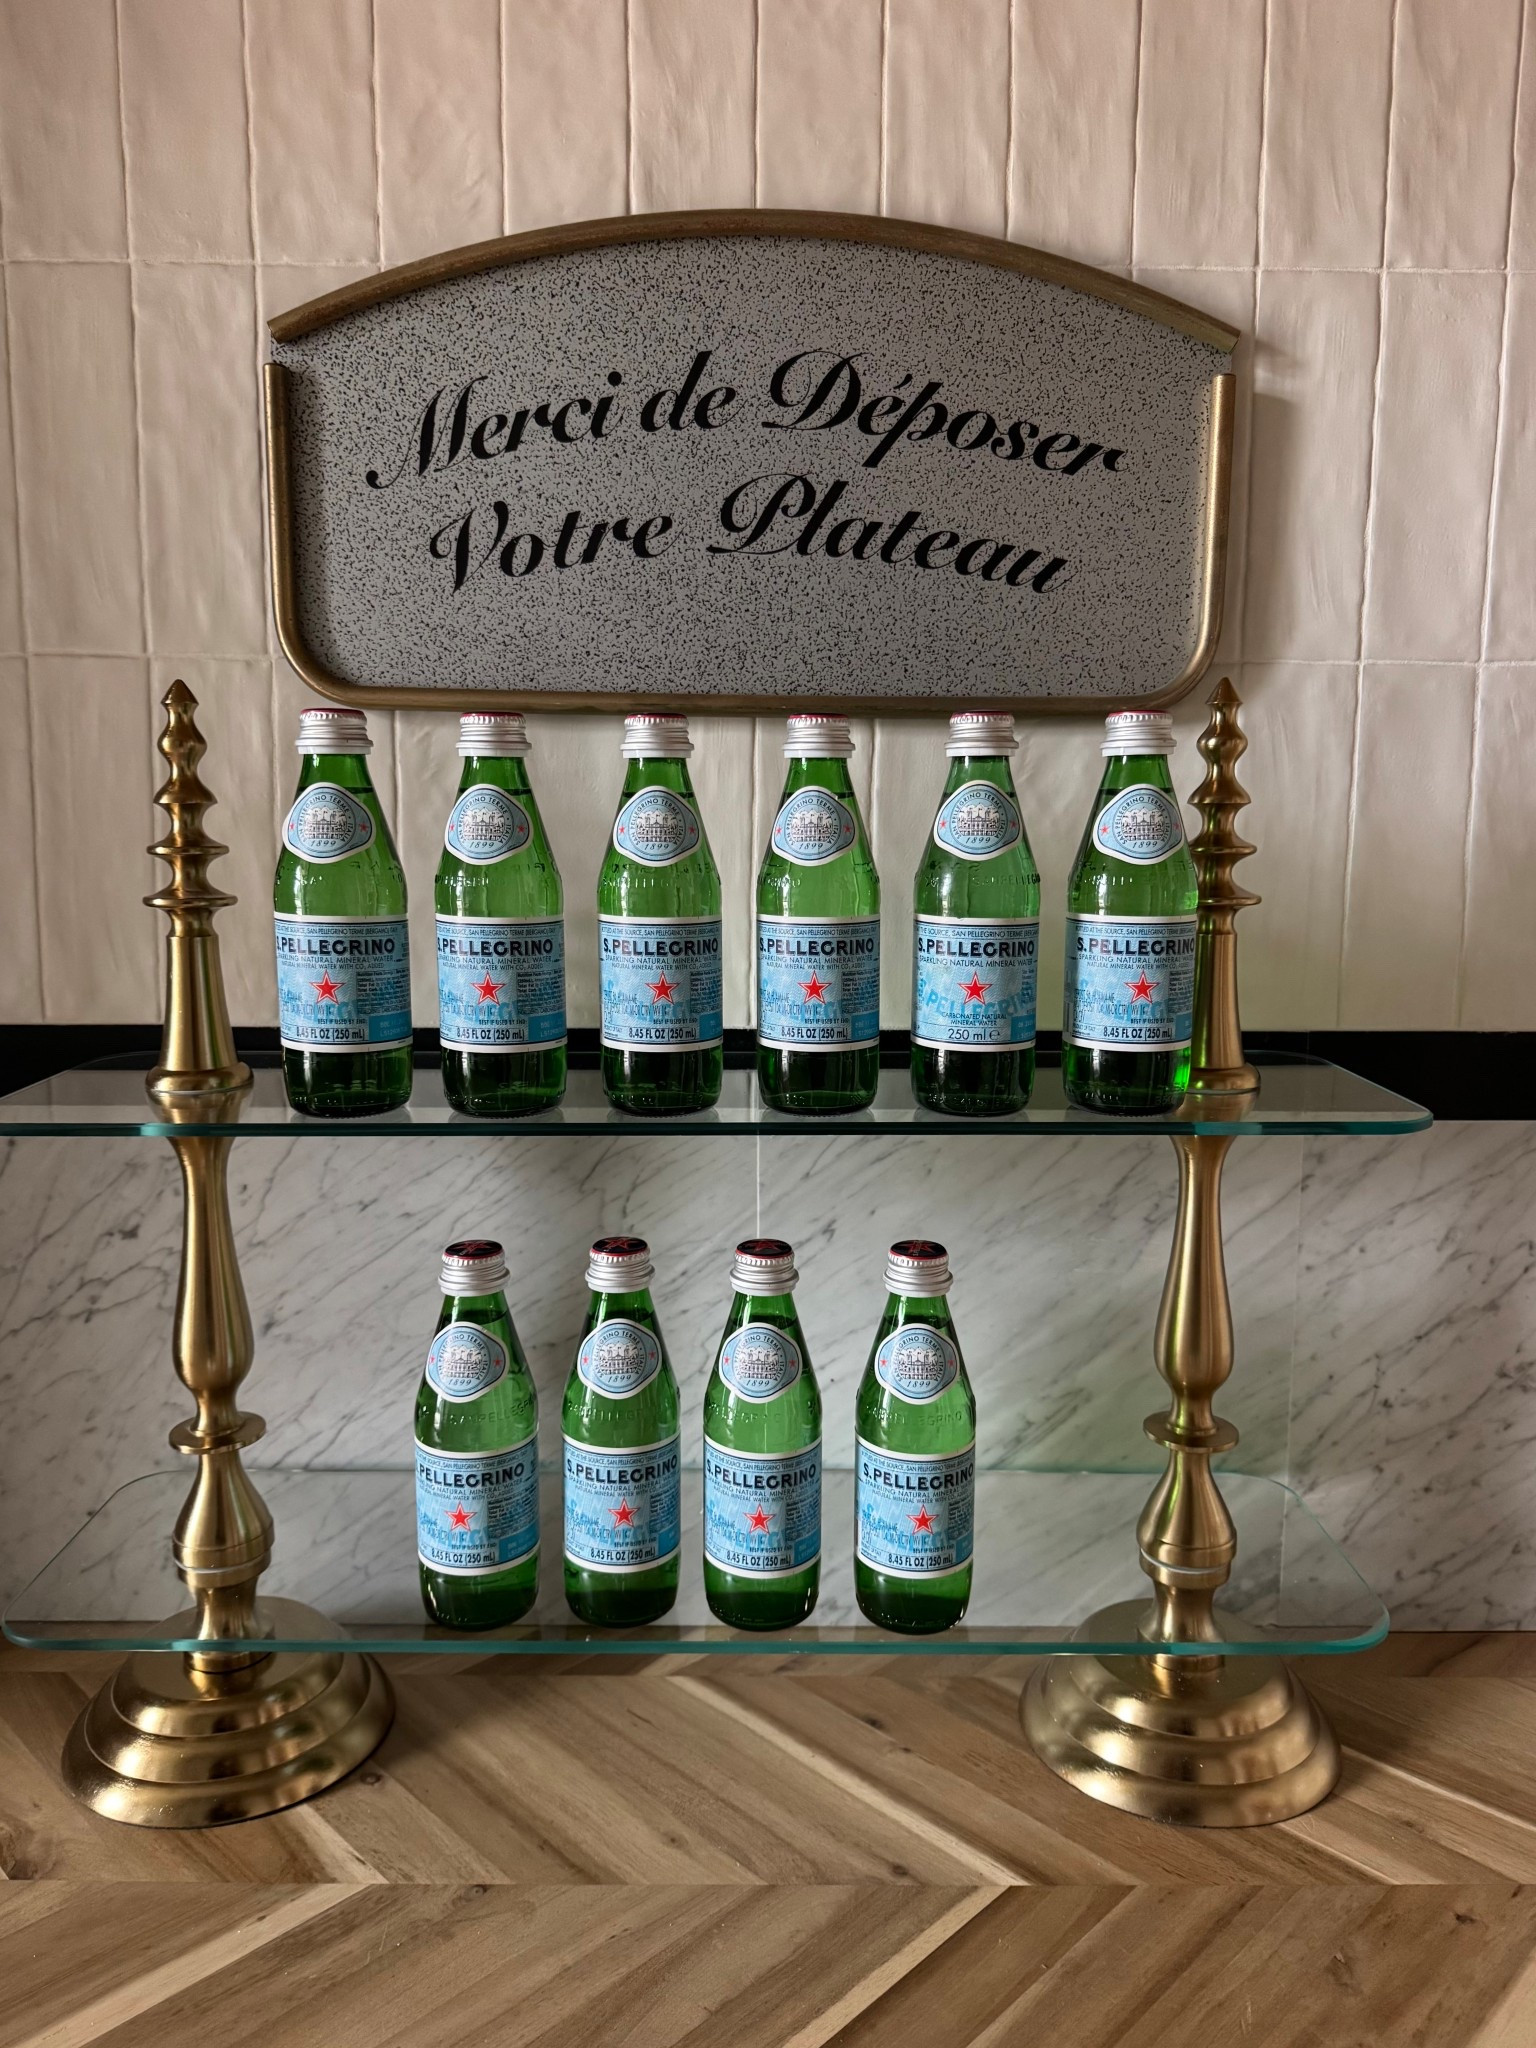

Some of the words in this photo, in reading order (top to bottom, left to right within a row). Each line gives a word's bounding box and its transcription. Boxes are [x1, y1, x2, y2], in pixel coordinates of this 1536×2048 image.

[365, 371, 626, 489] Merci
[640, 350, 746, 432] de
[761, 350, 1128, 476] Déposer
[430, 500, 682, 592] Votre
[706, 472, 1075, 593] Plateau
[329, 796, 350, 813] TERME
[488, 798, 508, 813] TERME
[661, 799, 680, 816] TERME
[817, 799, 835, 815] TERME
[984, 793, 1002, 808] TERME
[928, 928, 950, 936] SOURCE,
[968, 930, 1006, 938] PELLEGRINO
[336, 956, 370, 964] MINERAL
[606, 955, 635, 963] SPARKLING
[790, 956, 821, 964] NATURAL
[919, 955, 948, 965] SPARKLING
[950, 959, 983, 967] NATURAL
[985, 960, 1016, 968] MINERAL
[1078, 954, 1114, 963] SPARKLING
[942, 1012, 979, 1020] CARBONATED
[311, 1029, 317, 1038] FL
[320, 1030, 330, 1039] OZ
[332, 1028, 350, 1041] (250
[352, 1028, 365, 1040] mL)
[457, 1028, 469, 1038] 8.45
[472, 1029, 479, 1039] FL
[481, 1030, 491, 1039] OZ
[494, 1029, 510, 1042] (250
[512, 1028, 525, 1040] mL)
[629, 1028, 643, 1038] 8.45
[646, 1029, 652, 1038] FL
[656, 1030, 665, 1039] OZ
[668, 1029, 684, 1041] (250
[685, 1028, 696, 1039] mL)
[781, 1028, 795, 1038] 8.45
[797, 1029, 804, 1038] FL
[806, 1030, 816, 1039] OZ
[818, 1028, 835, 1041] (250
[837, 1028, 848, 1039] mL)
[948, 1028, 970, 1040] 250
[973, 1030, 986, 1040] ml
[1103, 1027, 1119, 1038] 8.45
[1122, 1028, 1129, 1038] FL
[1131, 1029, 1142, 1038] OZ
[1145, 1028, 1161, 1041] (250
[1162, 1028, 1173, 1039] mL)
[467, 1334, 485, 1349] TERME
[622, 1331, 640, 1345] TERME
[763, 1336, 781, 1350] TERME
[923, 1337, 940, 1351] TERME
[608, 1375, 631, 1383] 1899
[437, 1486, 466, 1495] NATURAL
[469, 1485, 501, 1494] MINERAL
[504, 1479, 523, 1489] WATER
[634, 1479, 661, 1490] MINERAL
[865, 1479, 896, 1495] SPARKLING
[898, 1490, 930, 1498] NATURAL
[933, 1488, 960, 1498] MINERAL
[736, 1488, 767, 1497] NATURAL
[770, 1488, 796, 1497] MINERAL
[445, 1552, 452, 1562] FL
[454, 1554, 464, 1563] OZ
[465, 1553, 481, 1566] (250
[483, 1551, 495, 1563] mL)
[591, 1549, 604, 1560] 8.45
[607, 1551, 614, 1561] FL
[616, 1552, 626, 1561] OZ
[628, 1549, 643, 1563] (250
[644, 1547, 656, 1558] mL)
[727, 1551, 739, 1563] 8.45
[742, 1554, 748, 1564] FL
[751, 1556, 761, 1566] OZ
[763, 1556, 778, 1568] (250
[780, 1554, 791, 1566] mL)
[888, 1553, 903, 1565] 8.45
[905, 1556, 912, 1566] FL
[914, 1556, 924, 1567] OZ
[926, 1556, 942, 1568] (250
[943, 1554, 953, 1565] mL)
